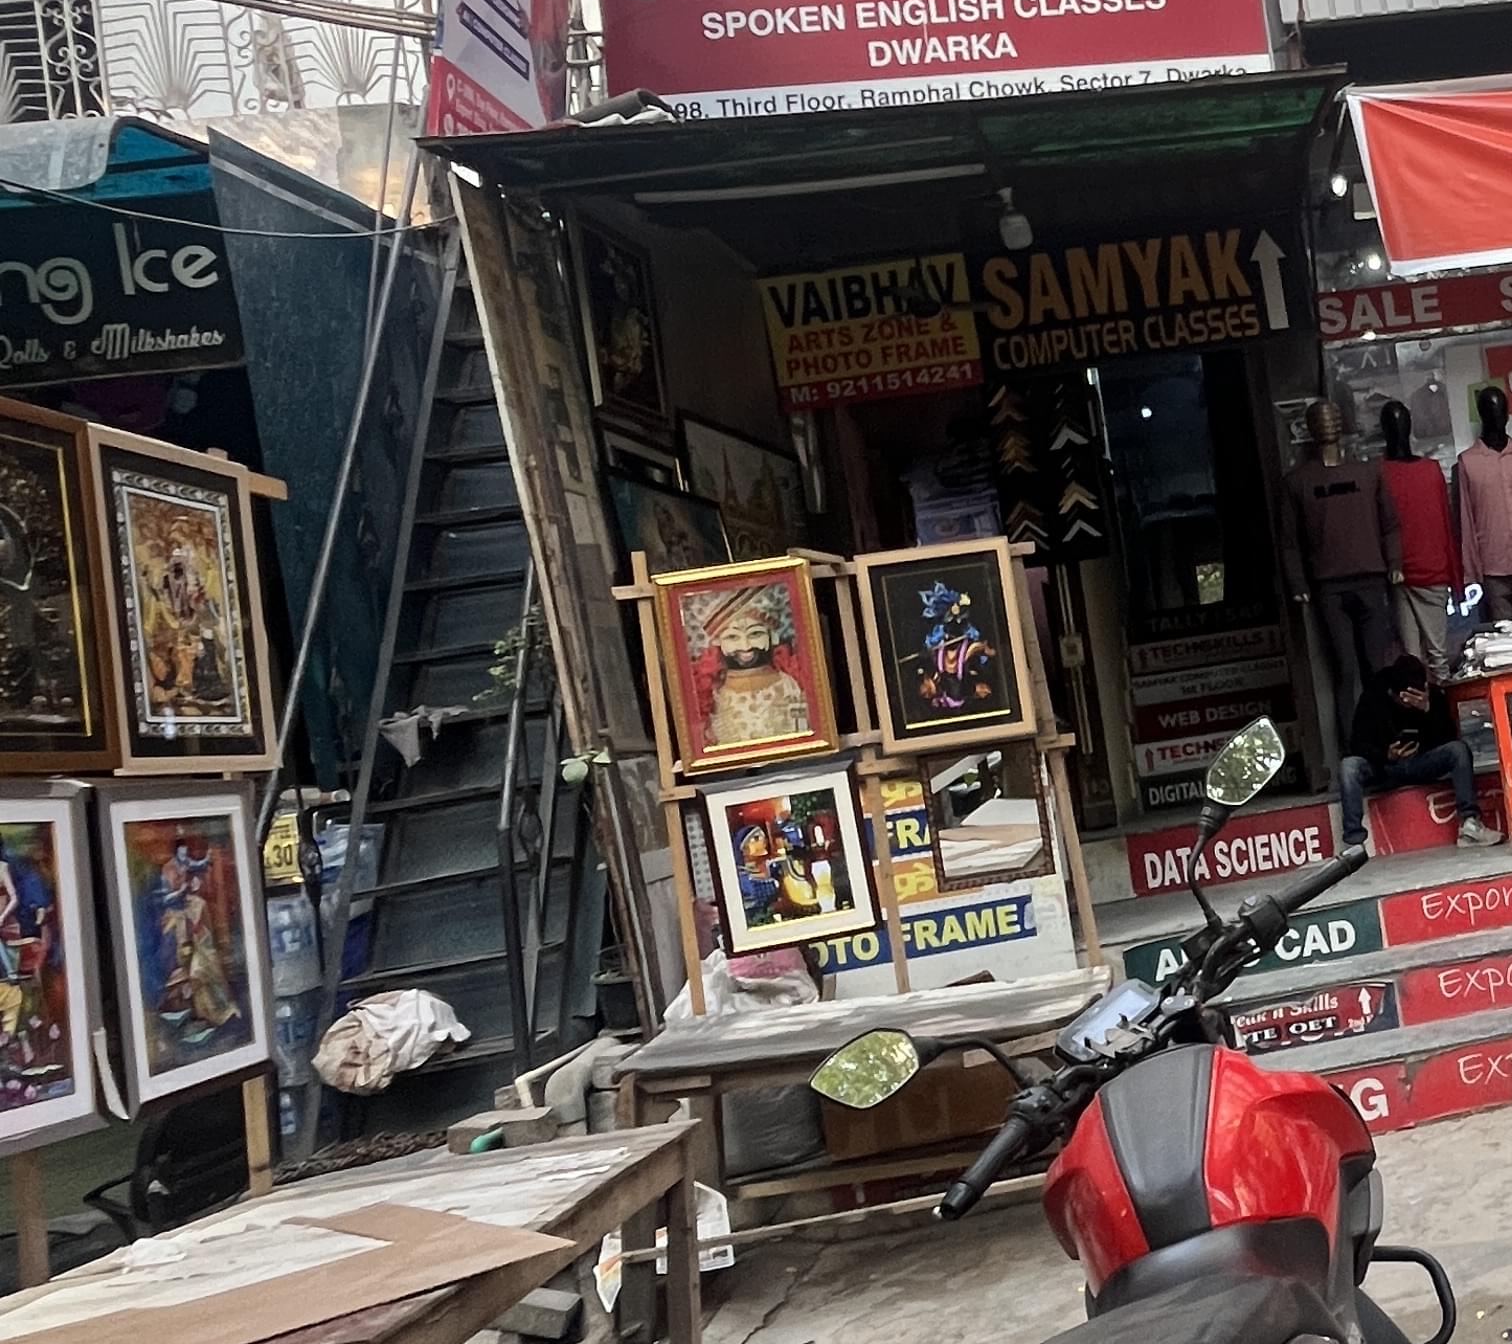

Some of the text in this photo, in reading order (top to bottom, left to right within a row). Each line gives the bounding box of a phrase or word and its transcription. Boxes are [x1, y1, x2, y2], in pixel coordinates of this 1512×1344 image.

[702, 5, 847, 41] SPOKEN
[867, 32, 1018, 68] DWARKA
[716, 96, 776, 118] Third
[861, 79, 960, 106] Ramphal
[1060, 70, 1131, 92] Sector
[112, 221, 219, 296] Ice
[982, 227, 1253, 331] SAMYAK
[767, 262, 957, 329] VAIBHAV
[1319, 286, 1445, 336] SALE
[90, 322, 226, 360] Milkshakes
[787, 310, 958, 355] ARTS ZONE &
[991, 303, 1261, 371] COMPUTER CLASSES
[786, 335, 968, 381] PHOTO FRAME
[826, 362, 974, 400] 9211514241
[1157, 699, 1273, 731] WEB DESIGN
[1143, 825, 1323, 890] DATA SCIENCE
